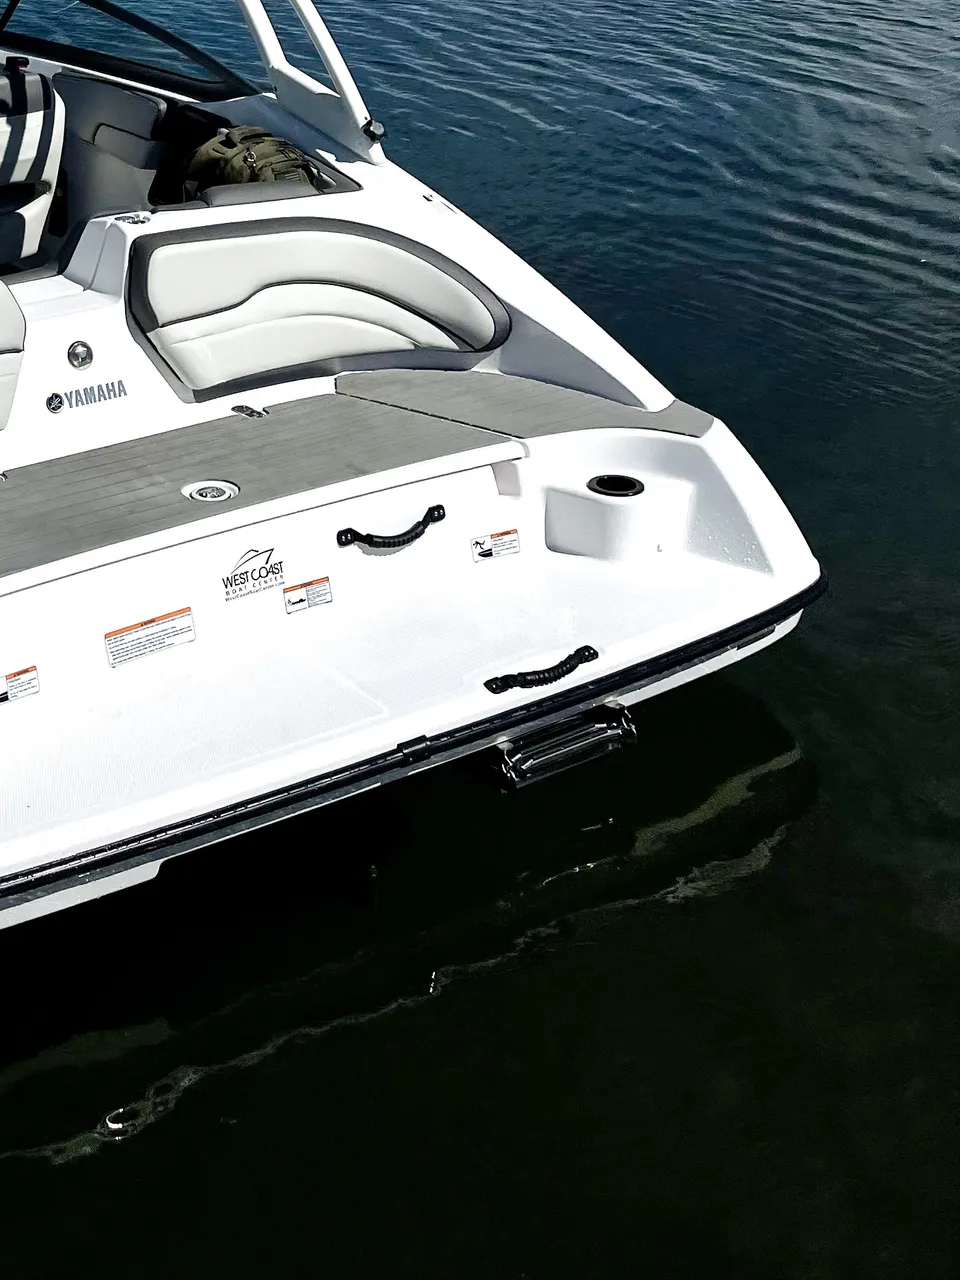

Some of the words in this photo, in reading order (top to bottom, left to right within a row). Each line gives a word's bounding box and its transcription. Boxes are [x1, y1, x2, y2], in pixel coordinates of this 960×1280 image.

[64, 379, 128, 408] YAMAHA
[222, 571, 249, 589] WEST
[251, 561, 283, 581] COAST
[226, 585, 247, 596] BOAT
[253, 574, 284, 588] CENTER
